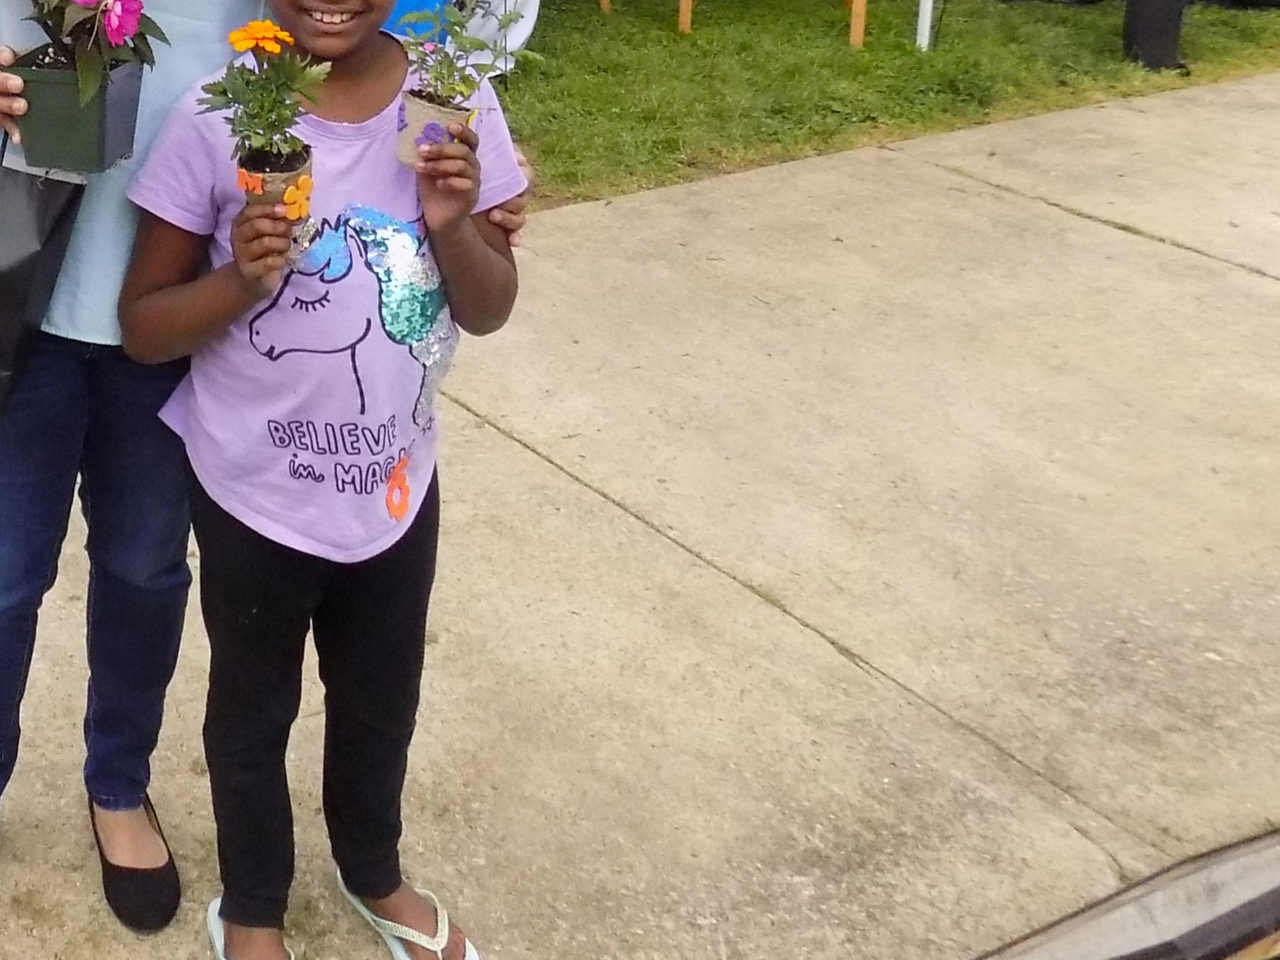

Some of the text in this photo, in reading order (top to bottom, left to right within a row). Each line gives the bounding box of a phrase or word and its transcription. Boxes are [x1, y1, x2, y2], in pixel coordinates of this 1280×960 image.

[268, 415, 397, 456] BELIEVE
[288, 447, 407, 494] in MAG
